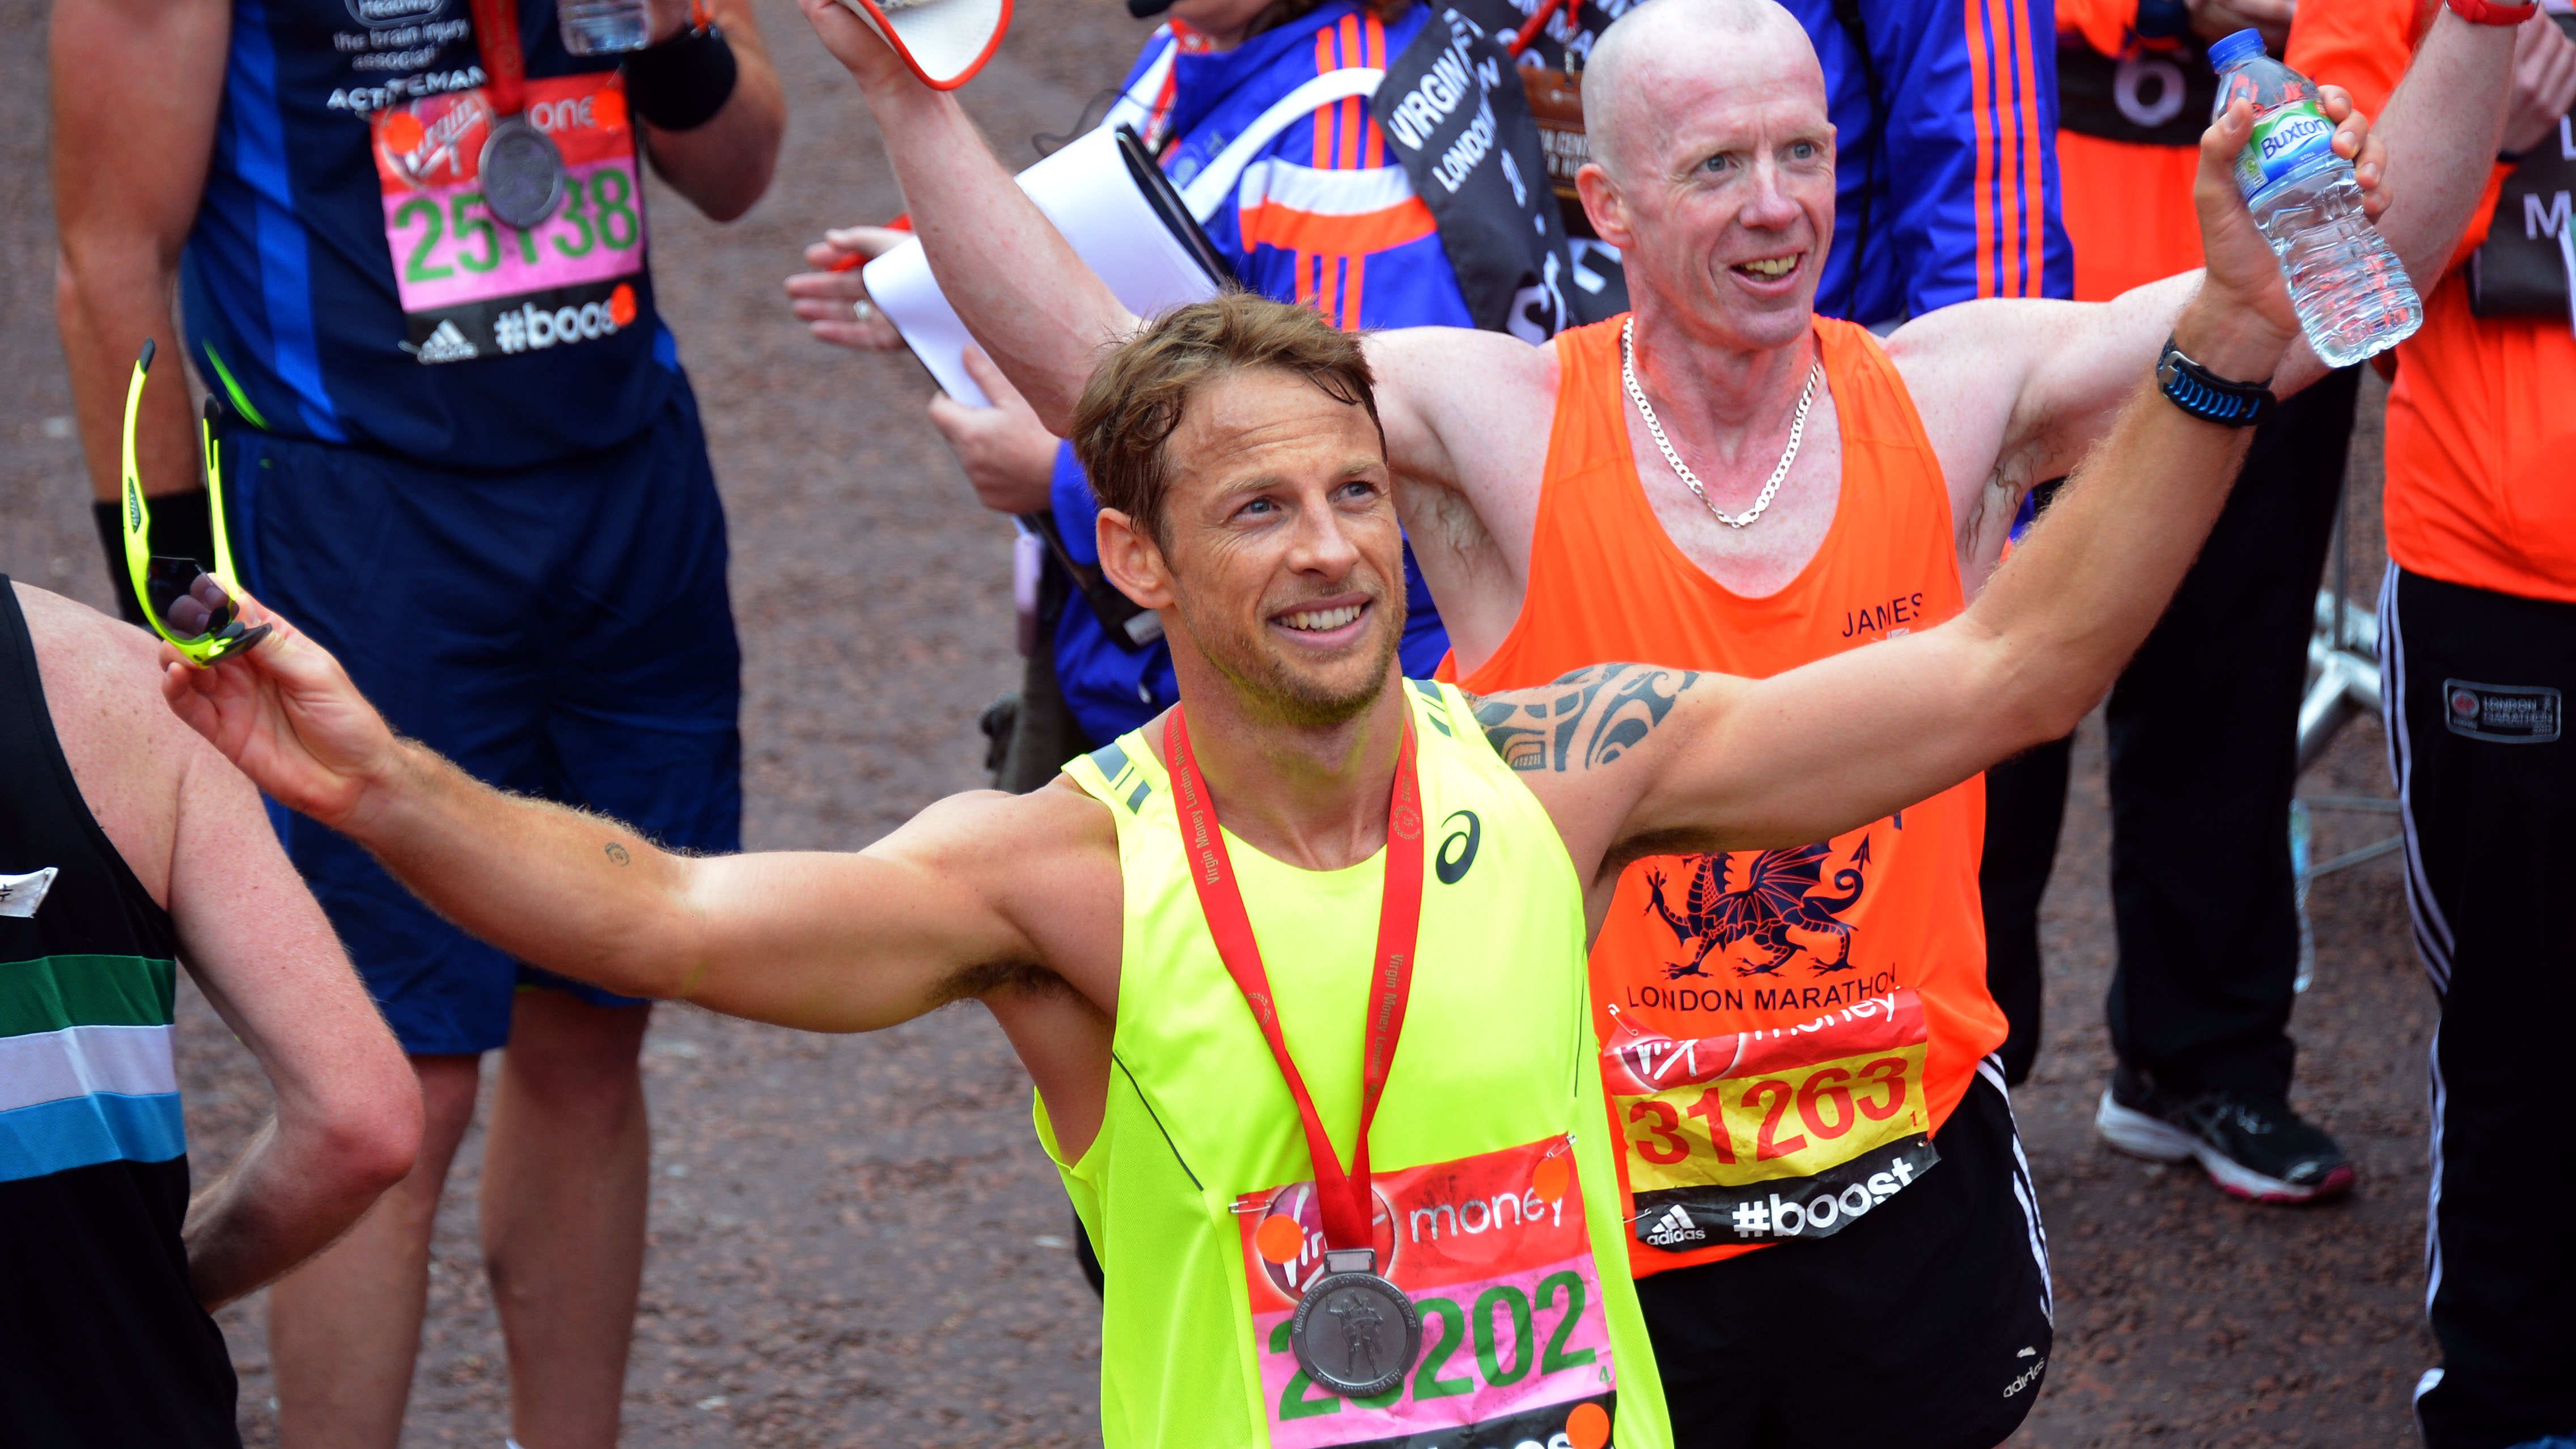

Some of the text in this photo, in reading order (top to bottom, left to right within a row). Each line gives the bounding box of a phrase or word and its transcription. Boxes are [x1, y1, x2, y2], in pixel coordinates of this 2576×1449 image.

[370, 23, 422, 49] brain
[526, 95, 596, 132] one
[1388, 47, 1471, 151] VIRGIN
[2261, 118, 2330, 159] Buxton
[2300, 151, 2316, 161] STILL
[493, 300, 619, 355] #boos
[1842, 593, 1923, 638] JAMES
[2483, 696, 2537, 711] LONDON
[1170, 712, 1220, 885] Virgin Money London Marathon
[1372, 954, 1404, 1078] Virgin Money London
[1627, 986, 1743, 1012] LONDON
[1629, 1057, 1908, 1165] 31263
[1909, 1110, 1918, 1126] 1
[1732, 1157, 1914, 1237] #boost
[1646, 1226, 1706, 1245] adidas
[1269, 1270, 1596, 1421] 2202
[1598, 1366, 1611, 1384] 4
[2003, 1356, 2045, 1398] adidas
